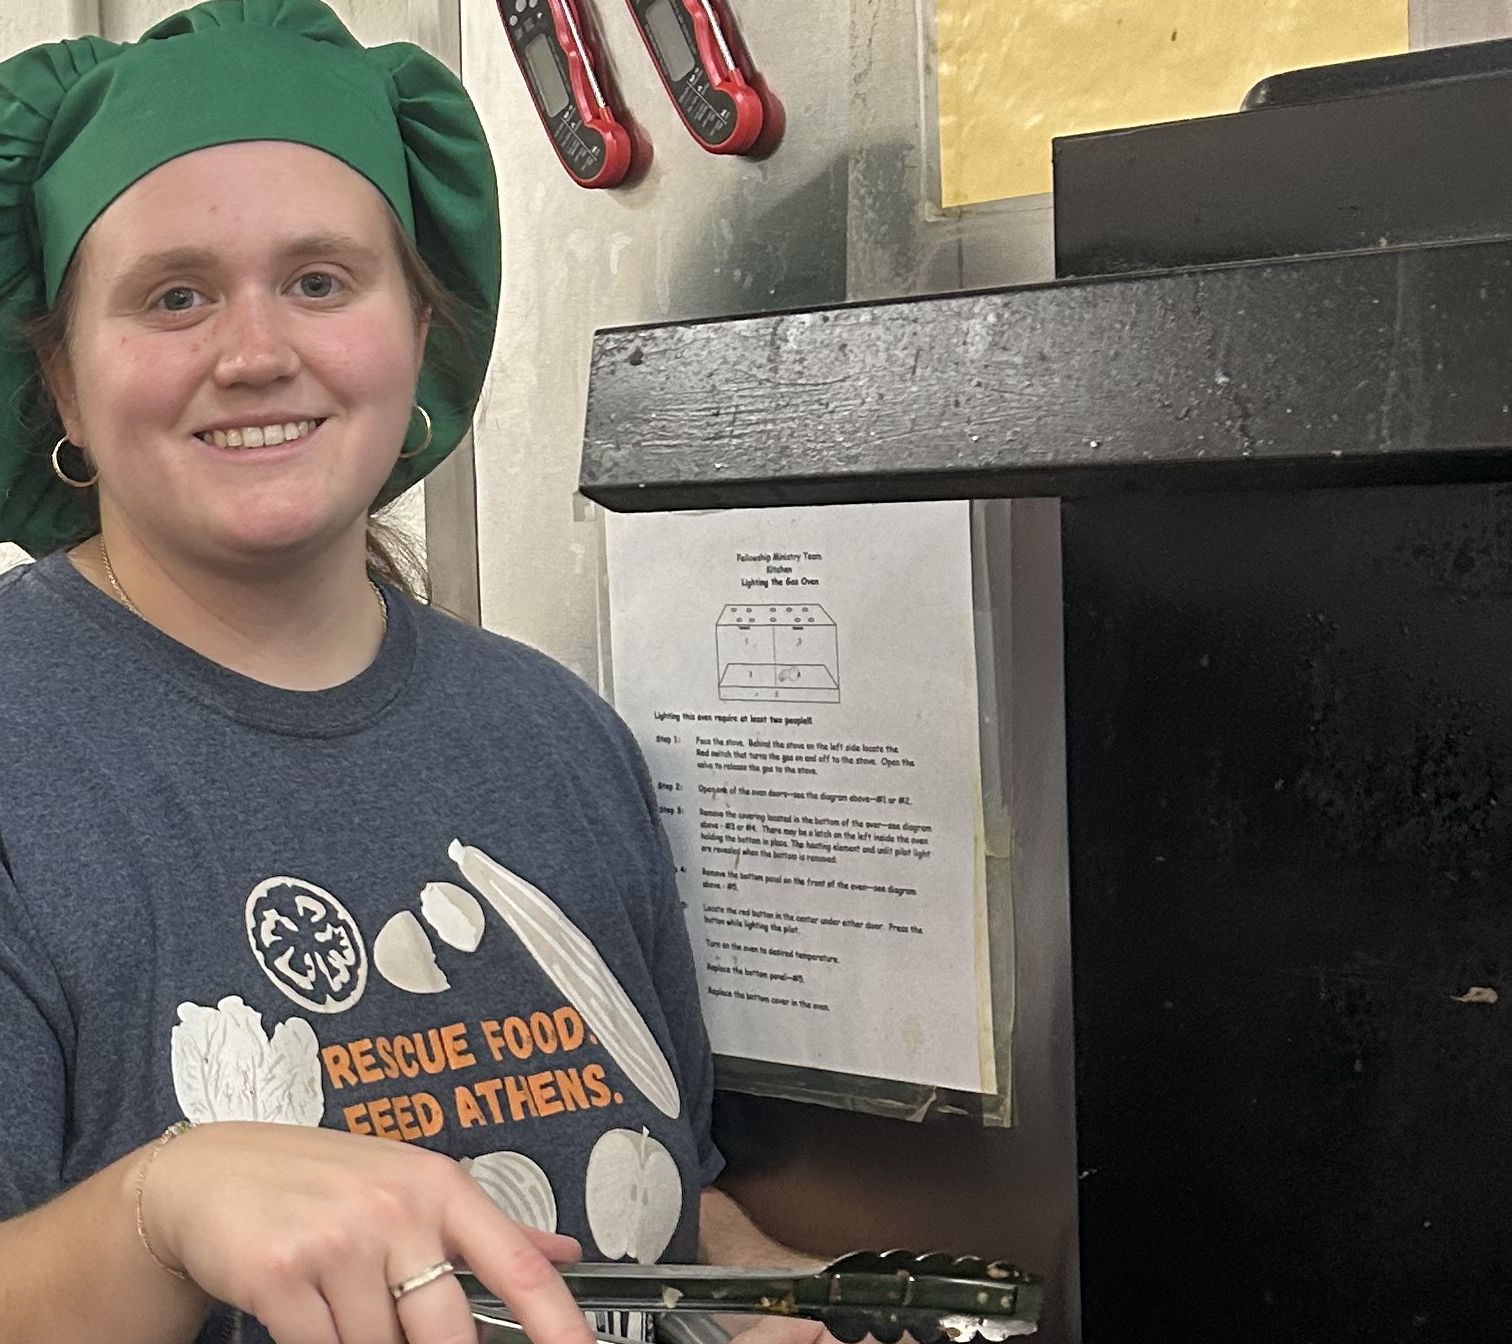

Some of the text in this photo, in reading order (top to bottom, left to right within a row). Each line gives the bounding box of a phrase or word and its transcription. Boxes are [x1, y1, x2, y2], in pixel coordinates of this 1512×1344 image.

[740, 576, 819, 588] Lighting the Gas Oven
[323, 1023, 475, 1089] RESCUE
[344, 1064, 623, 1141] FEED ATHENS.
